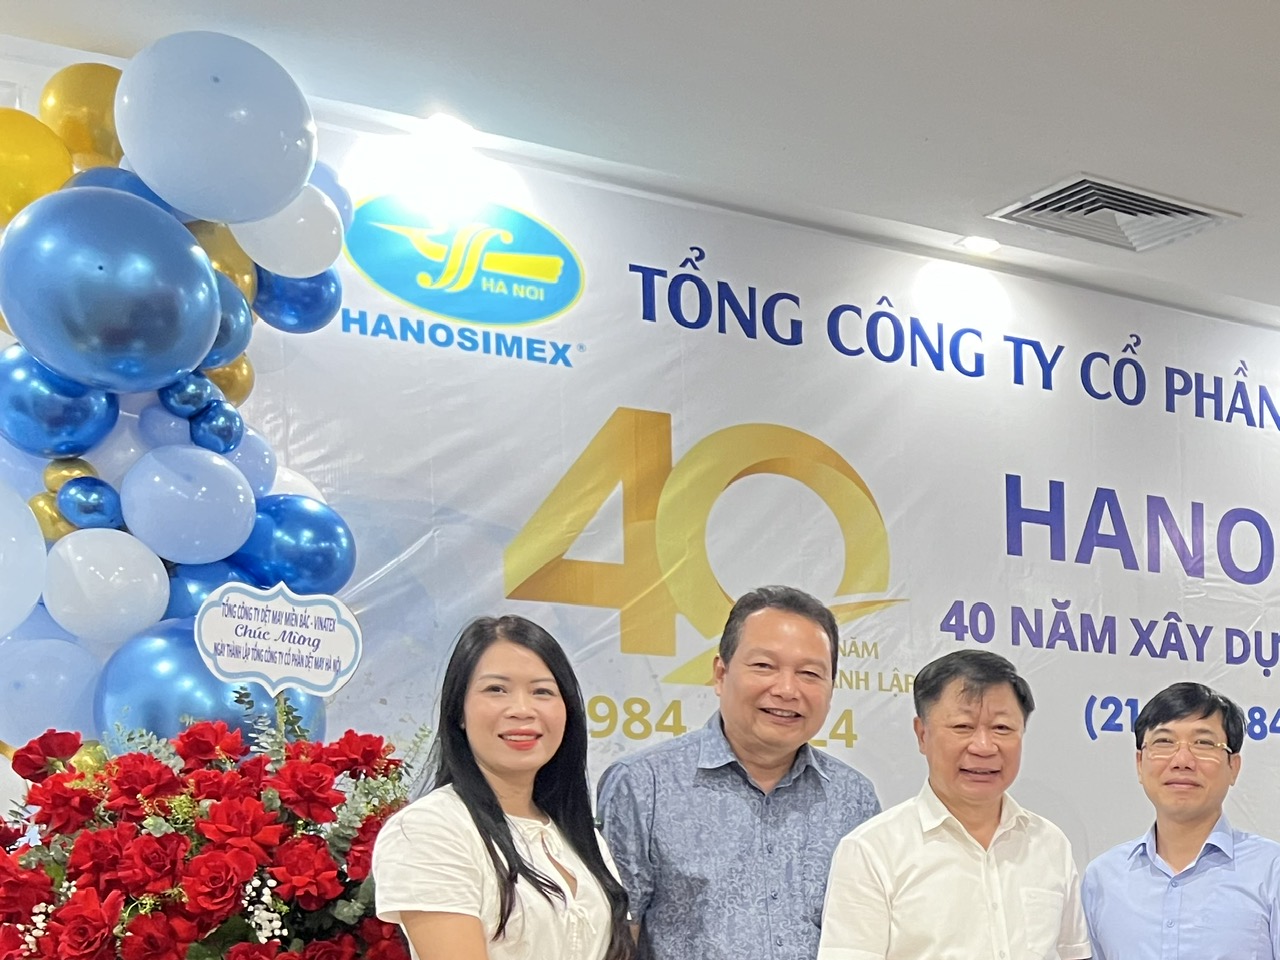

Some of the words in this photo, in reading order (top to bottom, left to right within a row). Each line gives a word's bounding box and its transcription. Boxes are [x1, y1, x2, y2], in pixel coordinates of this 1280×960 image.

[341, 308, 573, 368] HANOSIMEX
[629, 246, 803, 346] TỔNG
[827, 295, 985, 377] CÔNG
[1003, 335, 1065, 391] TY
[1080, 333, 1146, 406] CỔ
[504, 406, 893, 660] 40
[235, 624, 270, 640] Chúc
[274, 630, 321, 652] Mừng
[940, 600, 995, 643] 40
[1011, 598, 1117, 655] NĂM
[1130, 612, 1214, 662] XÂY
[587, 695, 687, 740] 984
